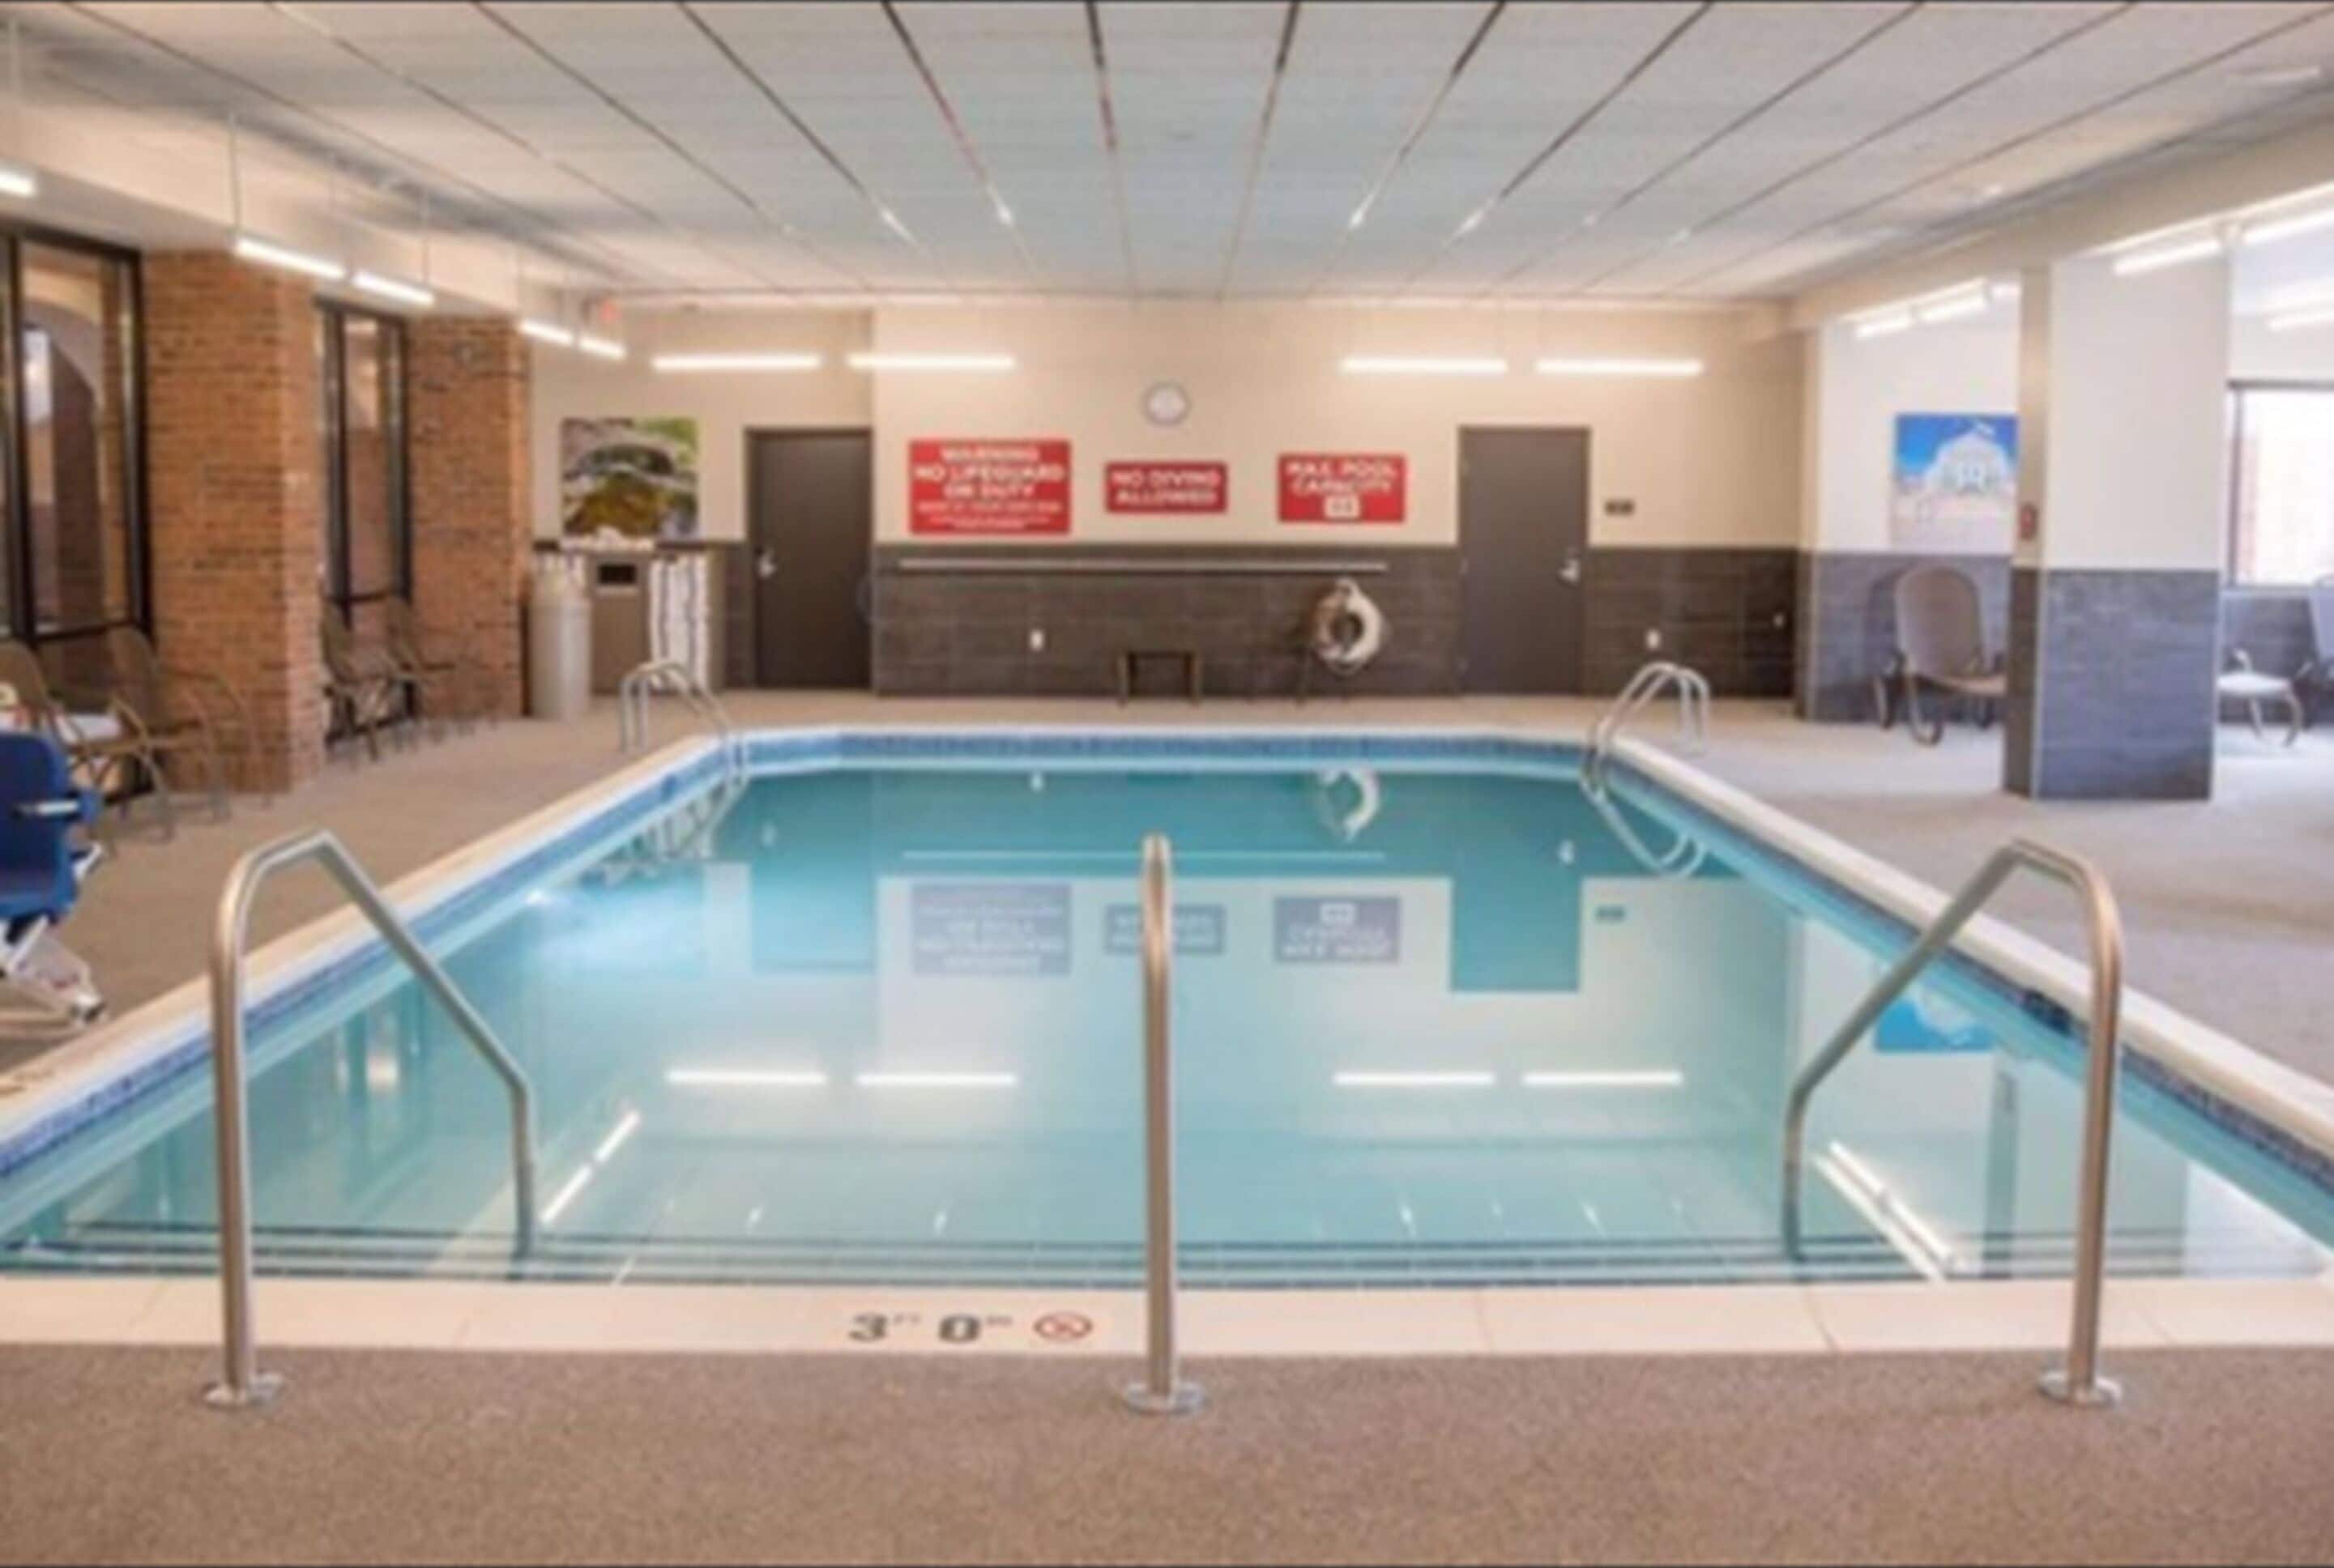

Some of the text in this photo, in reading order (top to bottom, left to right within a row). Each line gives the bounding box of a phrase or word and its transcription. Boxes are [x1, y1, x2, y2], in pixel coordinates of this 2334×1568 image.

[915, 464, 946, 481] NO
[1113, 471, 1144, 487] NO
[849, 1314, 888, 1342] 3
